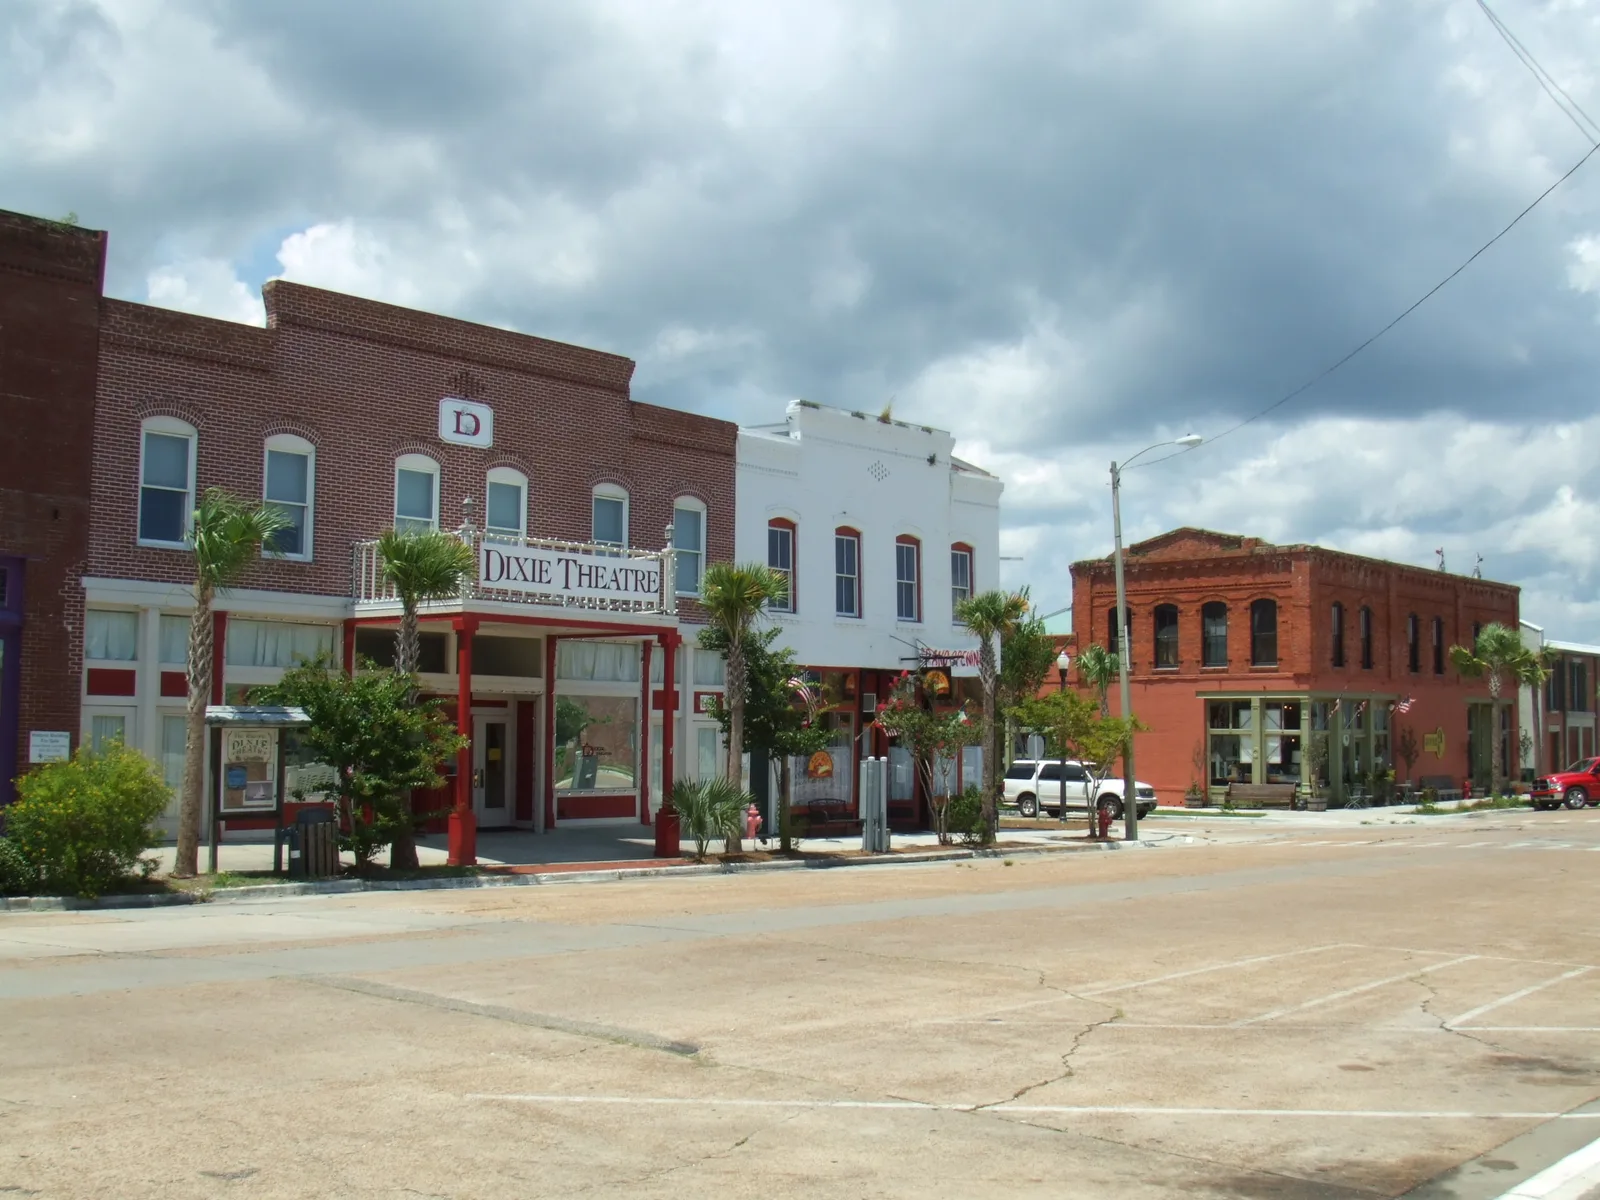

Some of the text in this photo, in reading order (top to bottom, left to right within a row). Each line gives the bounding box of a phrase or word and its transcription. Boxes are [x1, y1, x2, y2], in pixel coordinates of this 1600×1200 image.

[453, 410, 480, 436] D
[484, 549, 659, 594] DIXIE THEATRE
[232, 739, 268, 750] DIXIE
